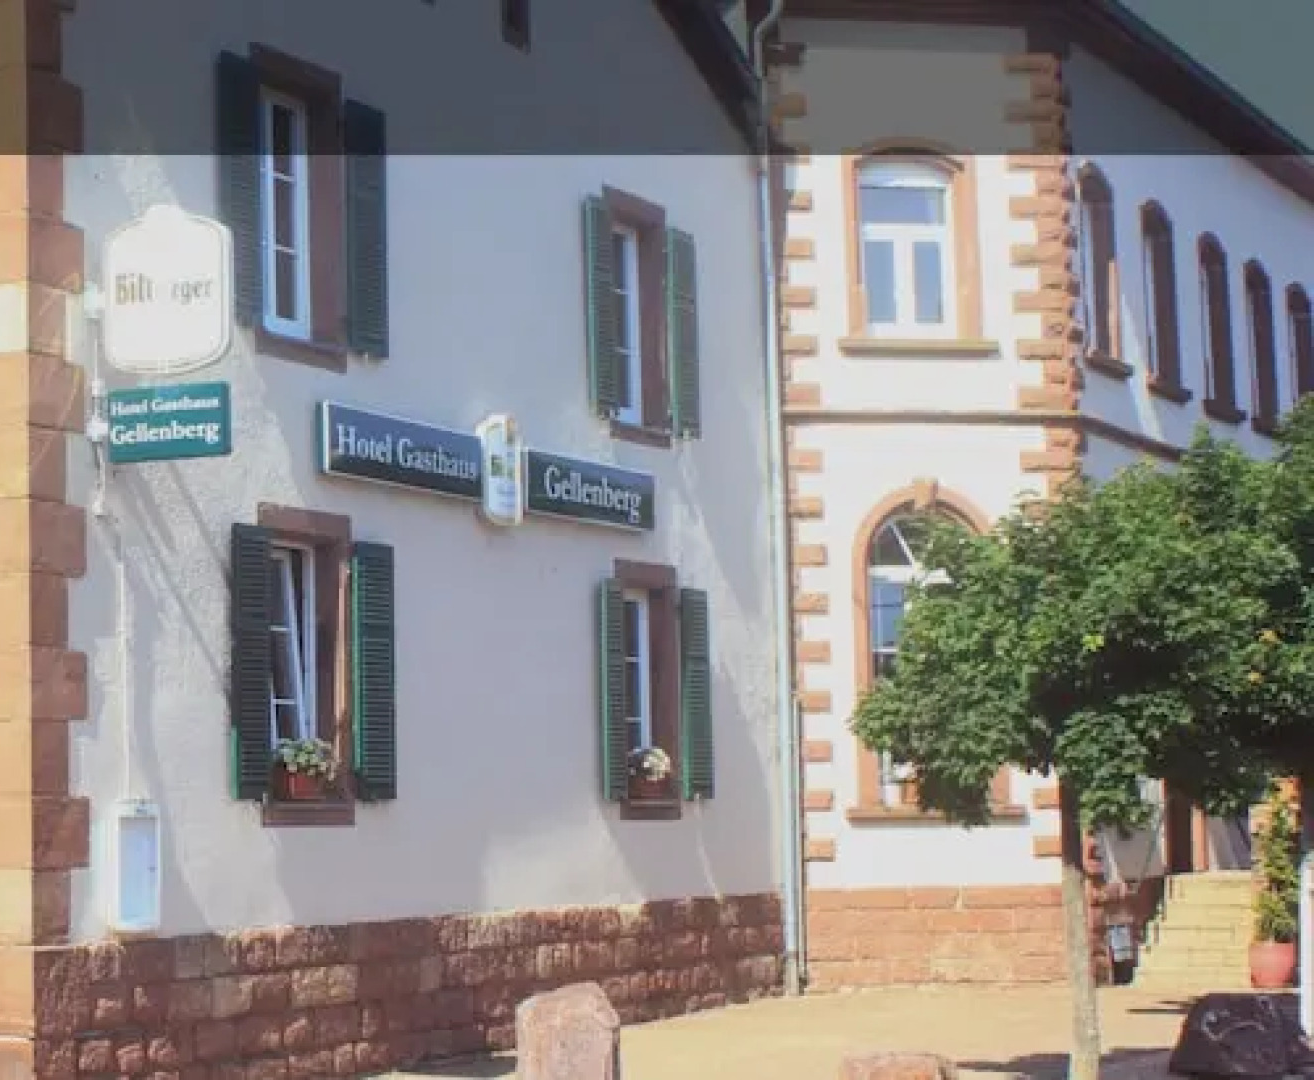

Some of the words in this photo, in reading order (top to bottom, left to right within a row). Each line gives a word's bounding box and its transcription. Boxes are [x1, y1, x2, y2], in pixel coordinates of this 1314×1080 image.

[115, 272, 212, 305] Bitrger
[110, 399, 148, 416] Hotel
[110, 420, 219, 445] Gellenberg
[338, 423, 393, 464] Hotel
[397, 438, 477, 481] Gasthaus
[544, 464, 642, 524] Gellenberg
